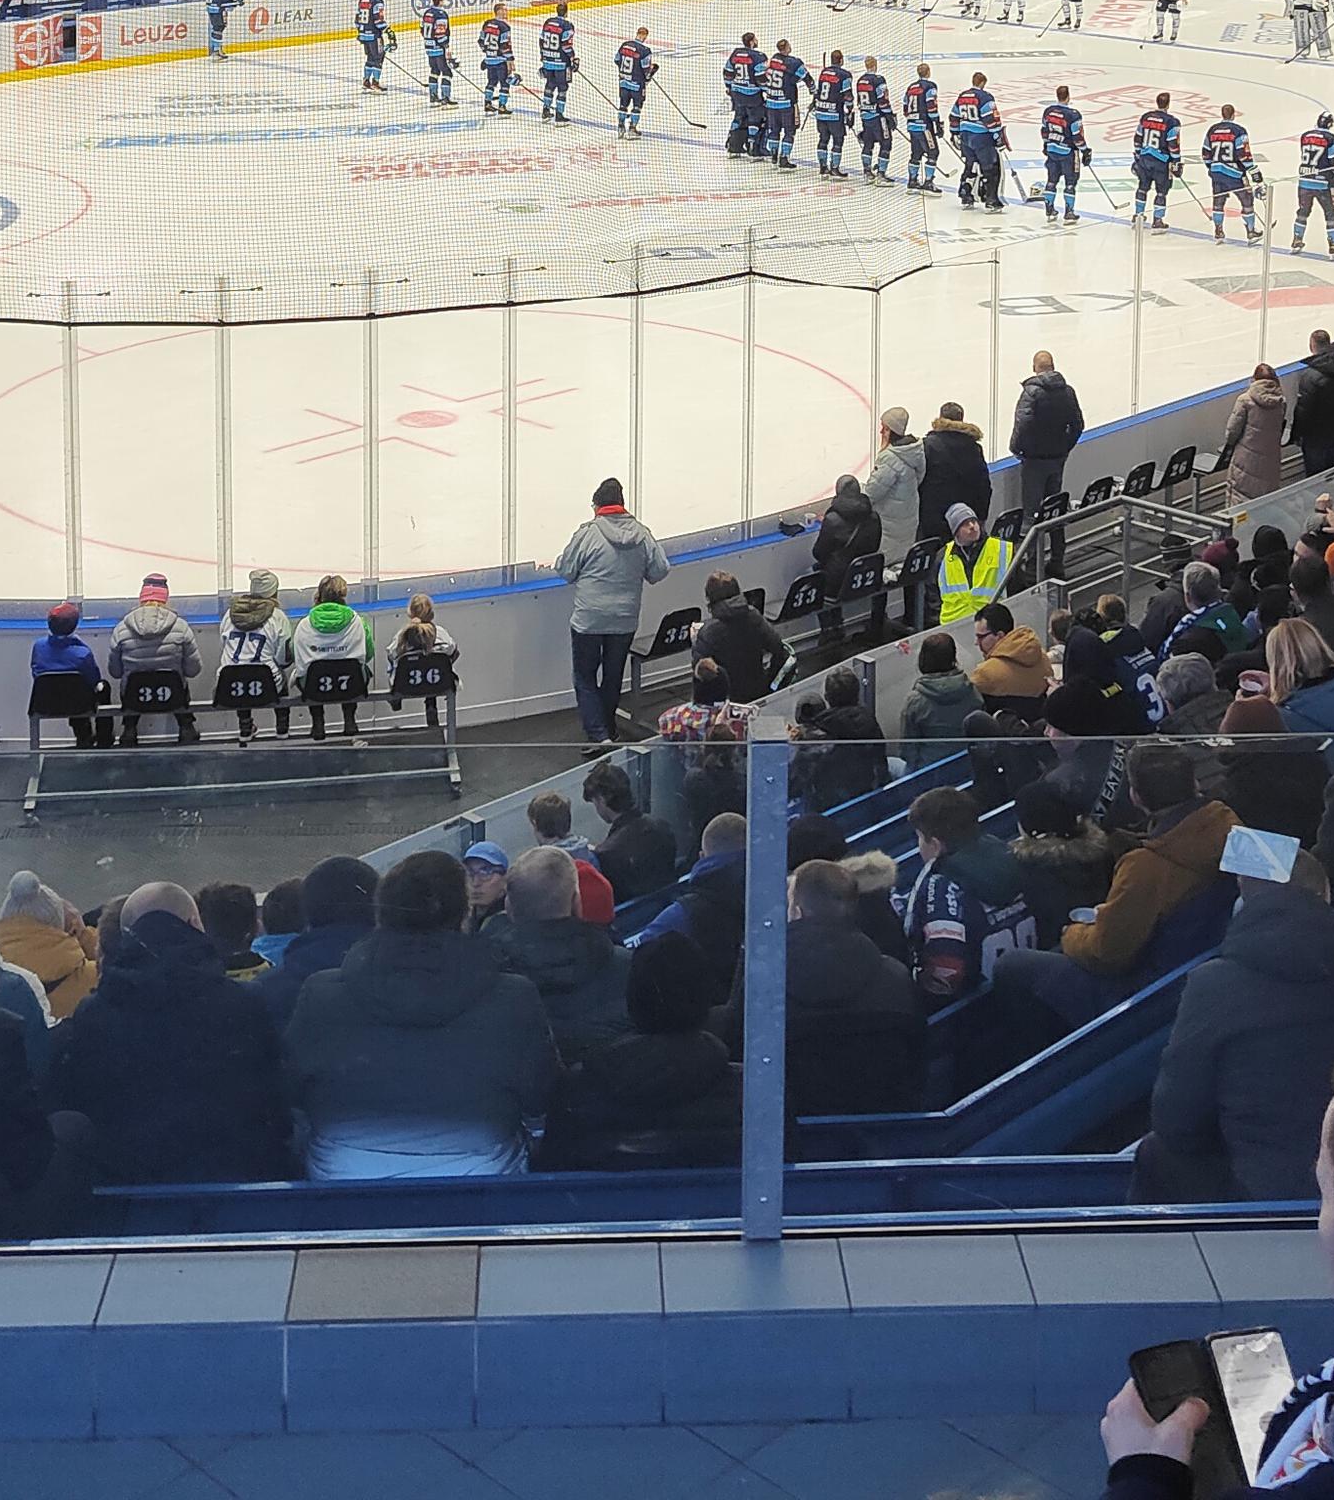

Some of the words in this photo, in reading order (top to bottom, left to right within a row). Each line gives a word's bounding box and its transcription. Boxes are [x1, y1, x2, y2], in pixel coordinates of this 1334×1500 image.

[273, 6, 314, 25] LEAR
[120, 21, 188, 46] Leuze
[910, 555, 933, 572] 31
[851, 571, 875, 590] 32
[793, 589, 818, 608] 33
[664, 627, 690, 645] 35
[228, 631, 267, 663] 77
[319, 675, 351, 692] 37
[409, 668, 441, 685] 36
[138, 685, 172, 703] 39
[230, 681, 262, 698] 38
